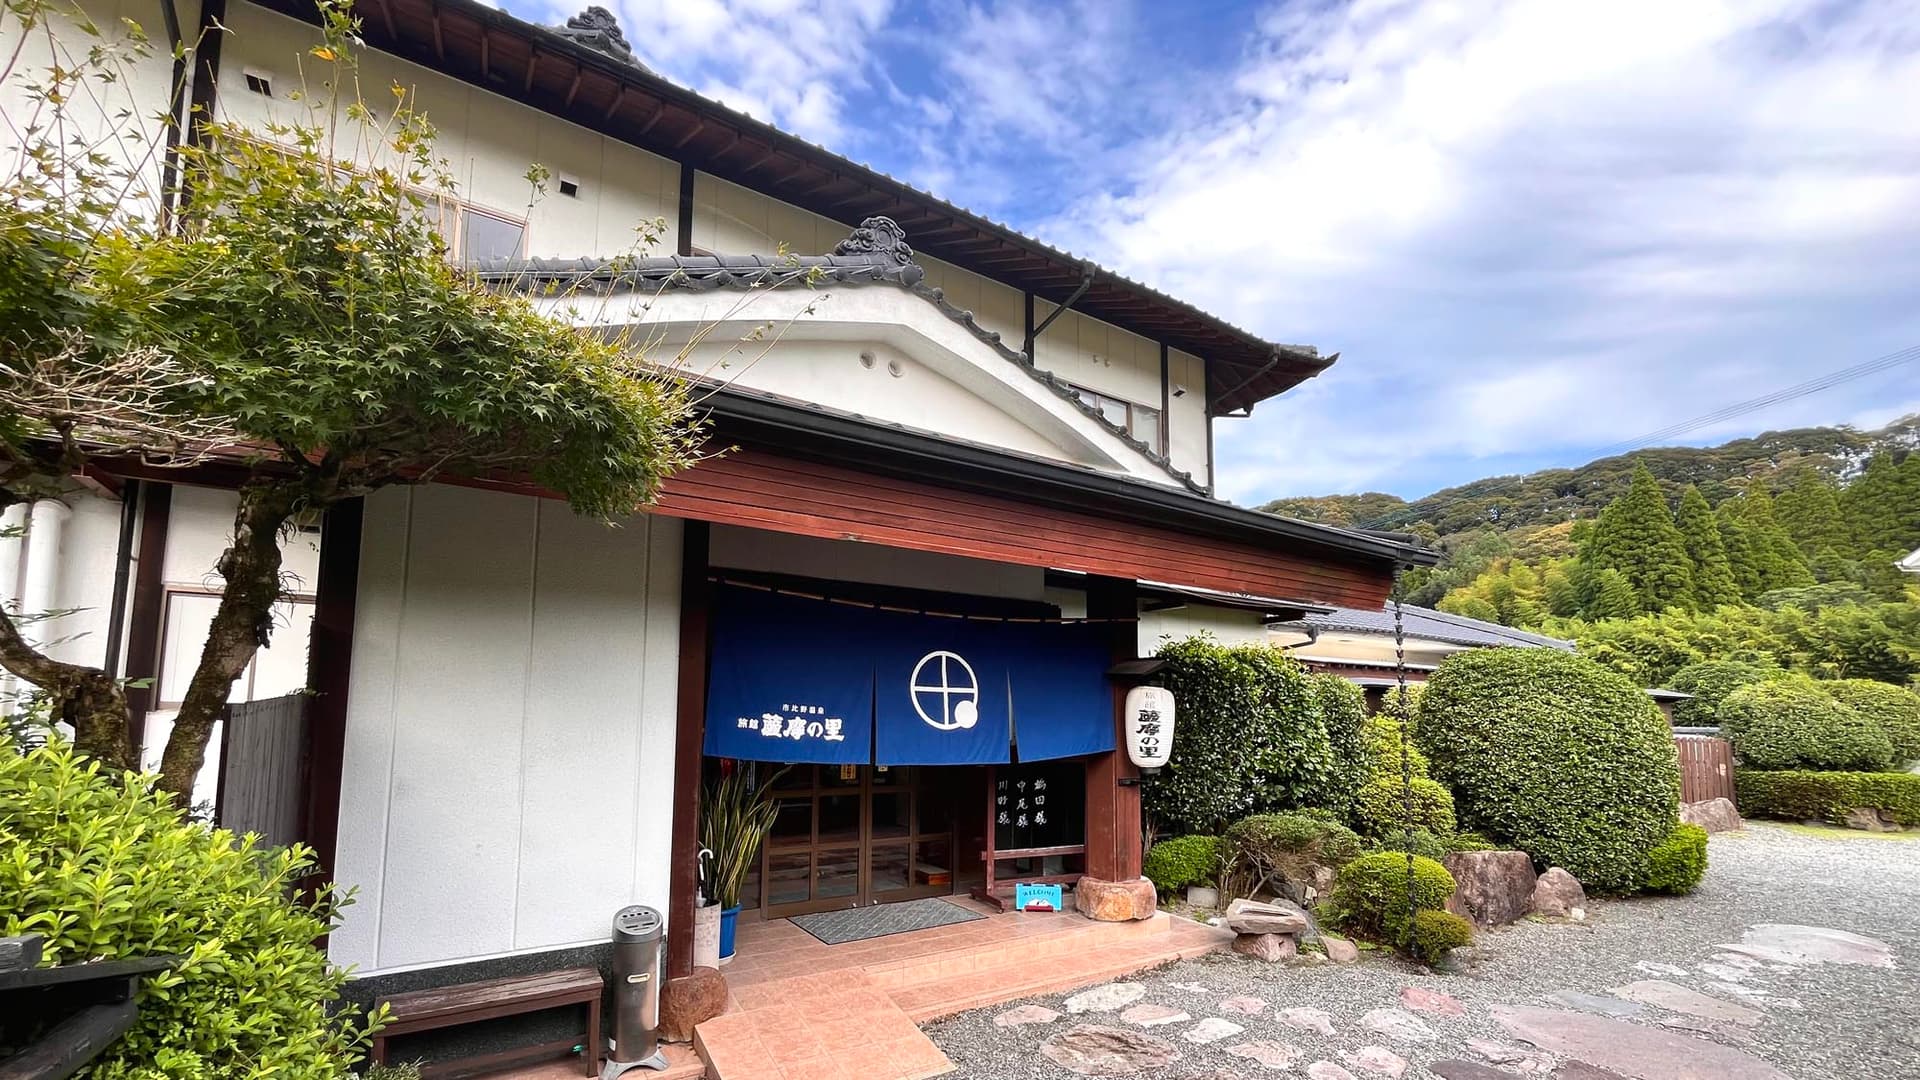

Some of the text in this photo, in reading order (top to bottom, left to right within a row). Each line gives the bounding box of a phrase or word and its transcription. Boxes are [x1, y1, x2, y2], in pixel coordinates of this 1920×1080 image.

[761, 713, 844, 740] 薩摩の里
[1136, 709, 1161, 758] 薩摩の里
